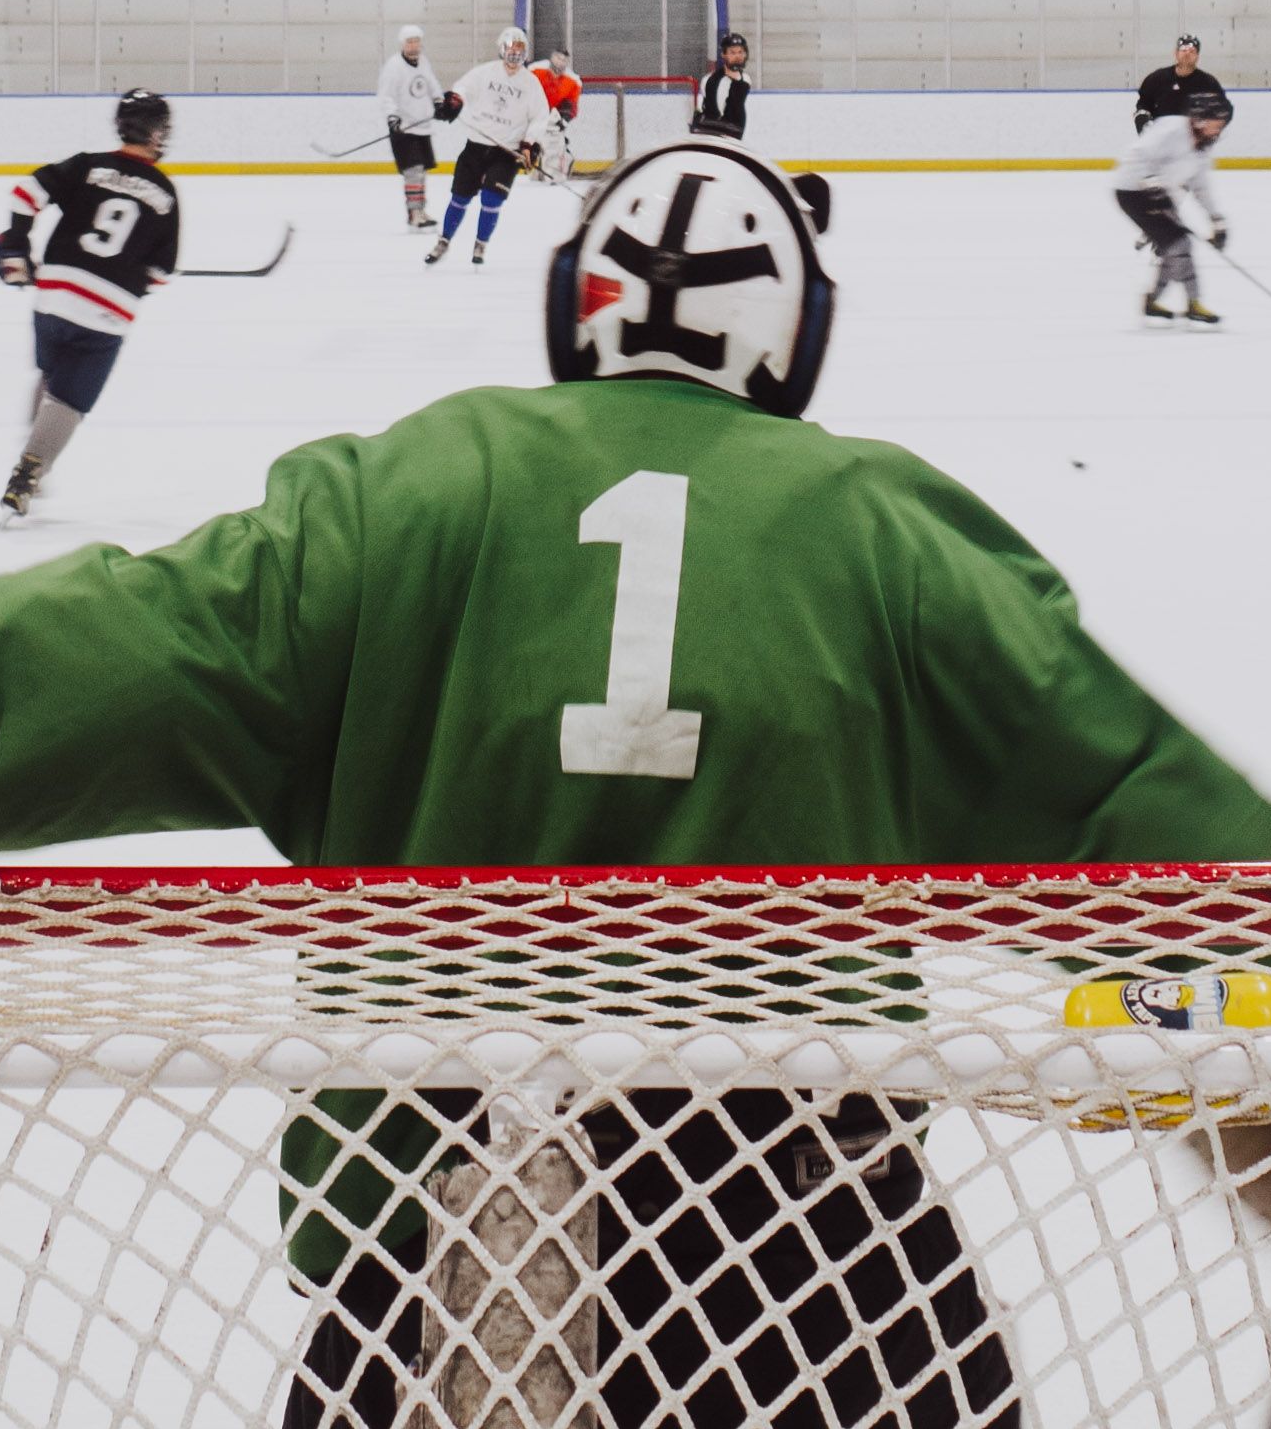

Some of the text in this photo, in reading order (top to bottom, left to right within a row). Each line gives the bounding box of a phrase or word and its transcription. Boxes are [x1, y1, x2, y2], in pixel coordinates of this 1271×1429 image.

[489, 81, 522, 99] KENT
[79, 198, 141, 258] 9
[560, 469, 702, 780] 1
